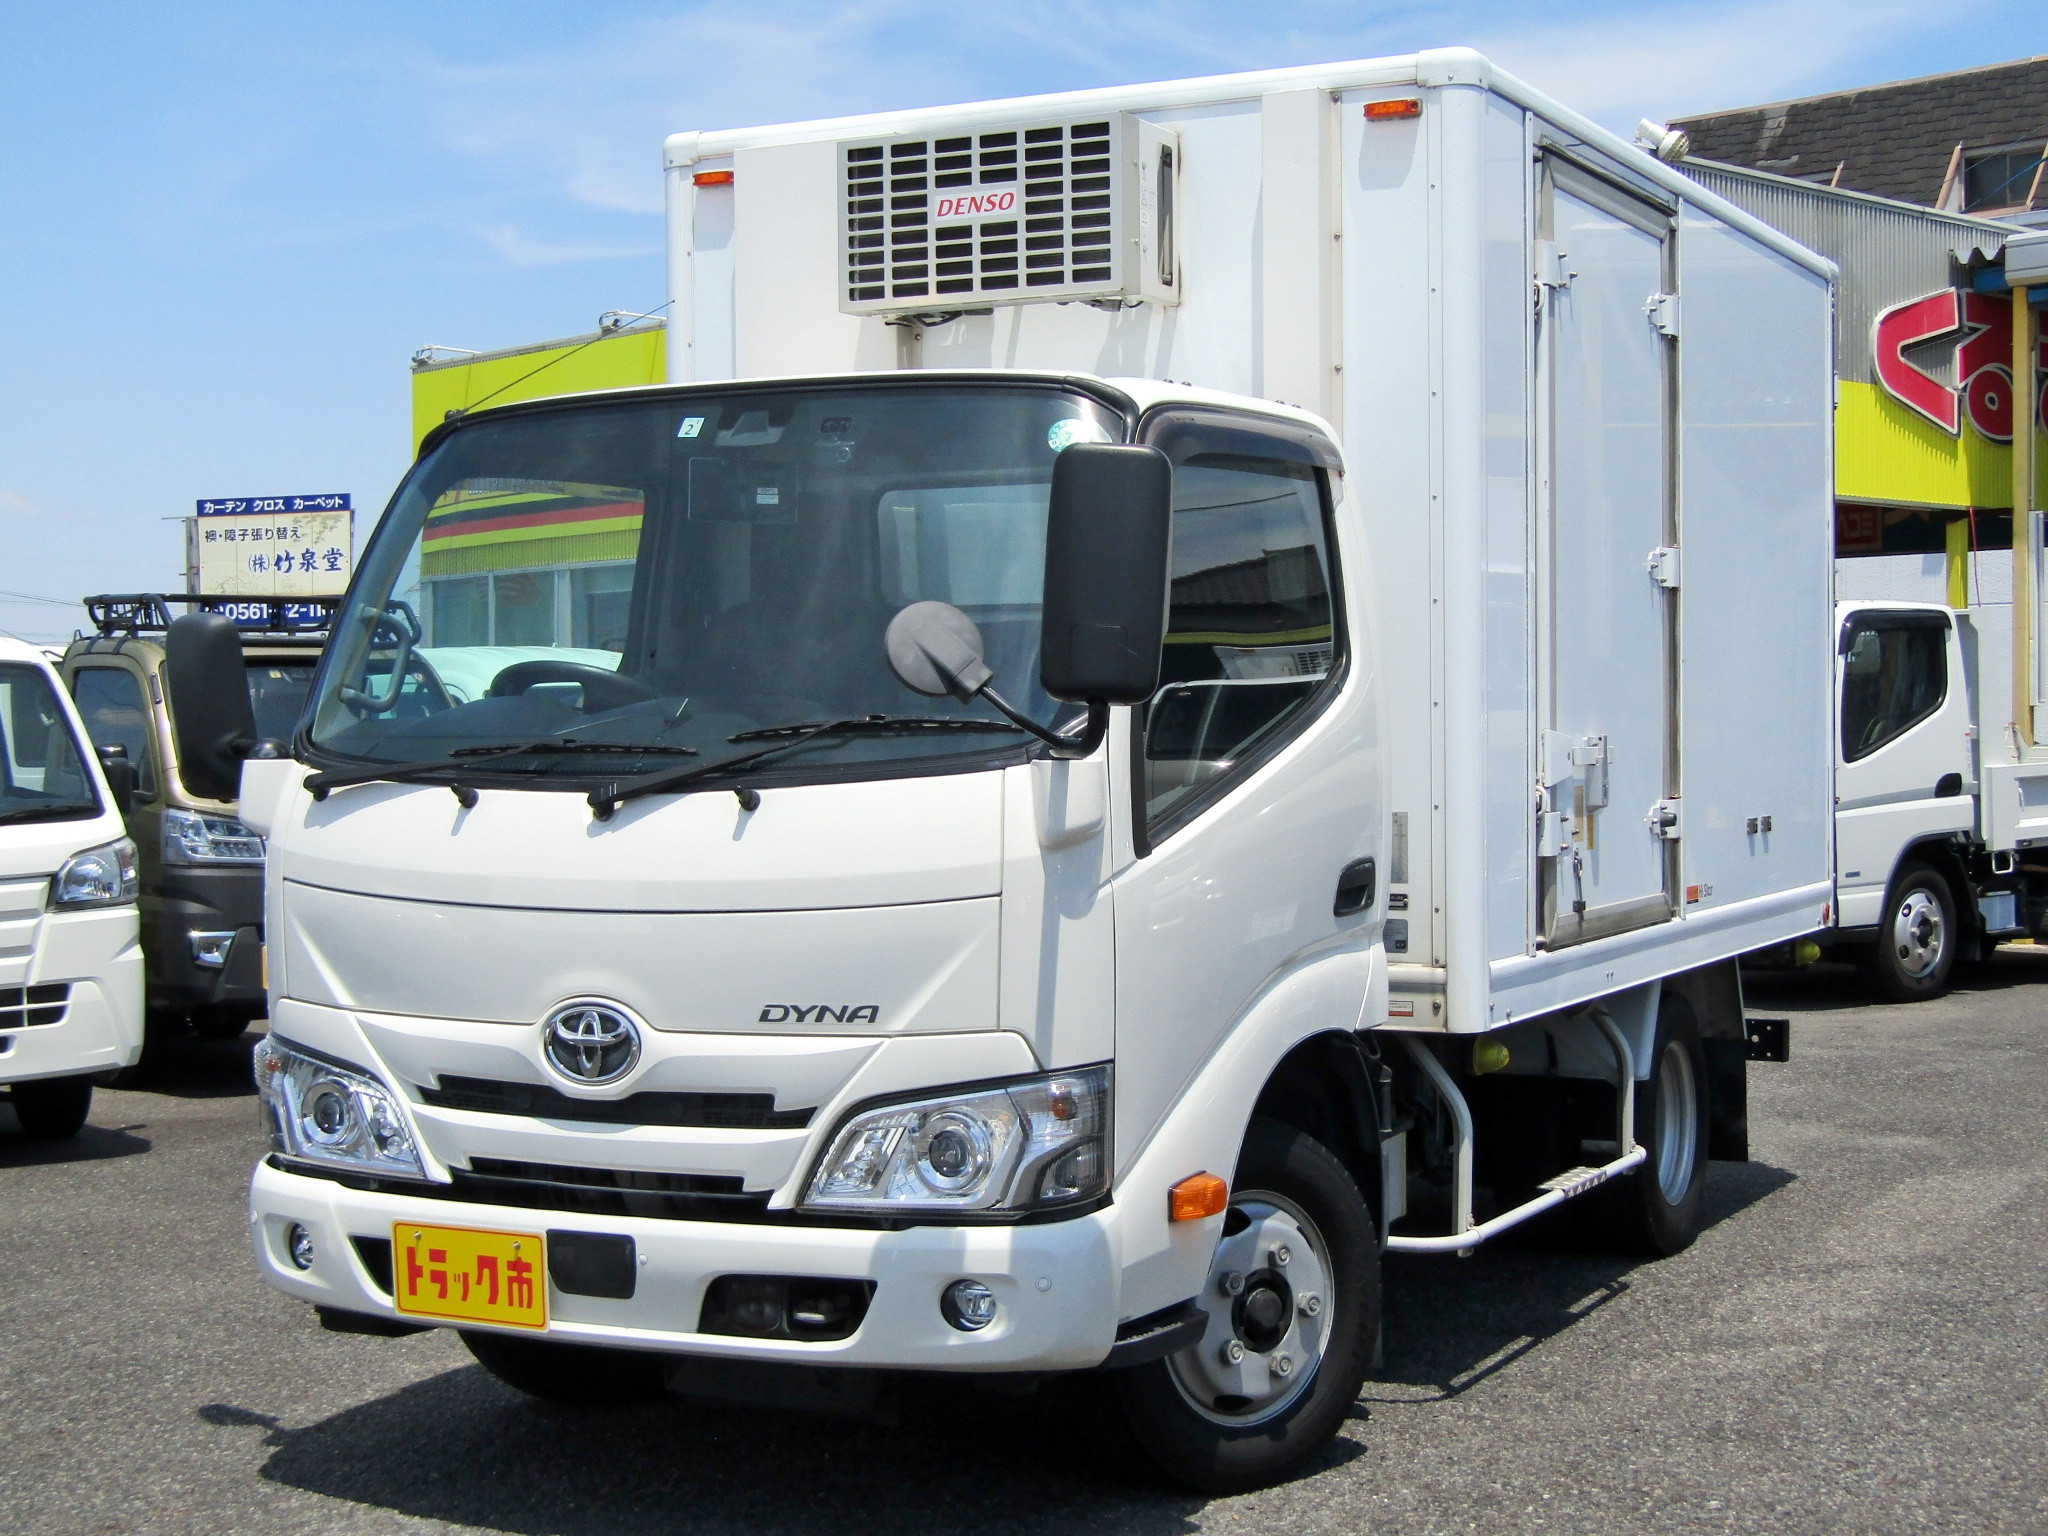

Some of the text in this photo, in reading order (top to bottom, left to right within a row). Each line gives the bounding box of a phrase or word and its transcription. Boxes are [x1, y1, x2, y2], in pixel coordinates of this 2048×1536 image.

[937, 192, 1015, 217] DENSO
[204, 496, 343, 513] カーテン クロス カーペット
[759, 1004, 879, 1023] DYNA
[406, 1246, 534, 1309] トラック市
